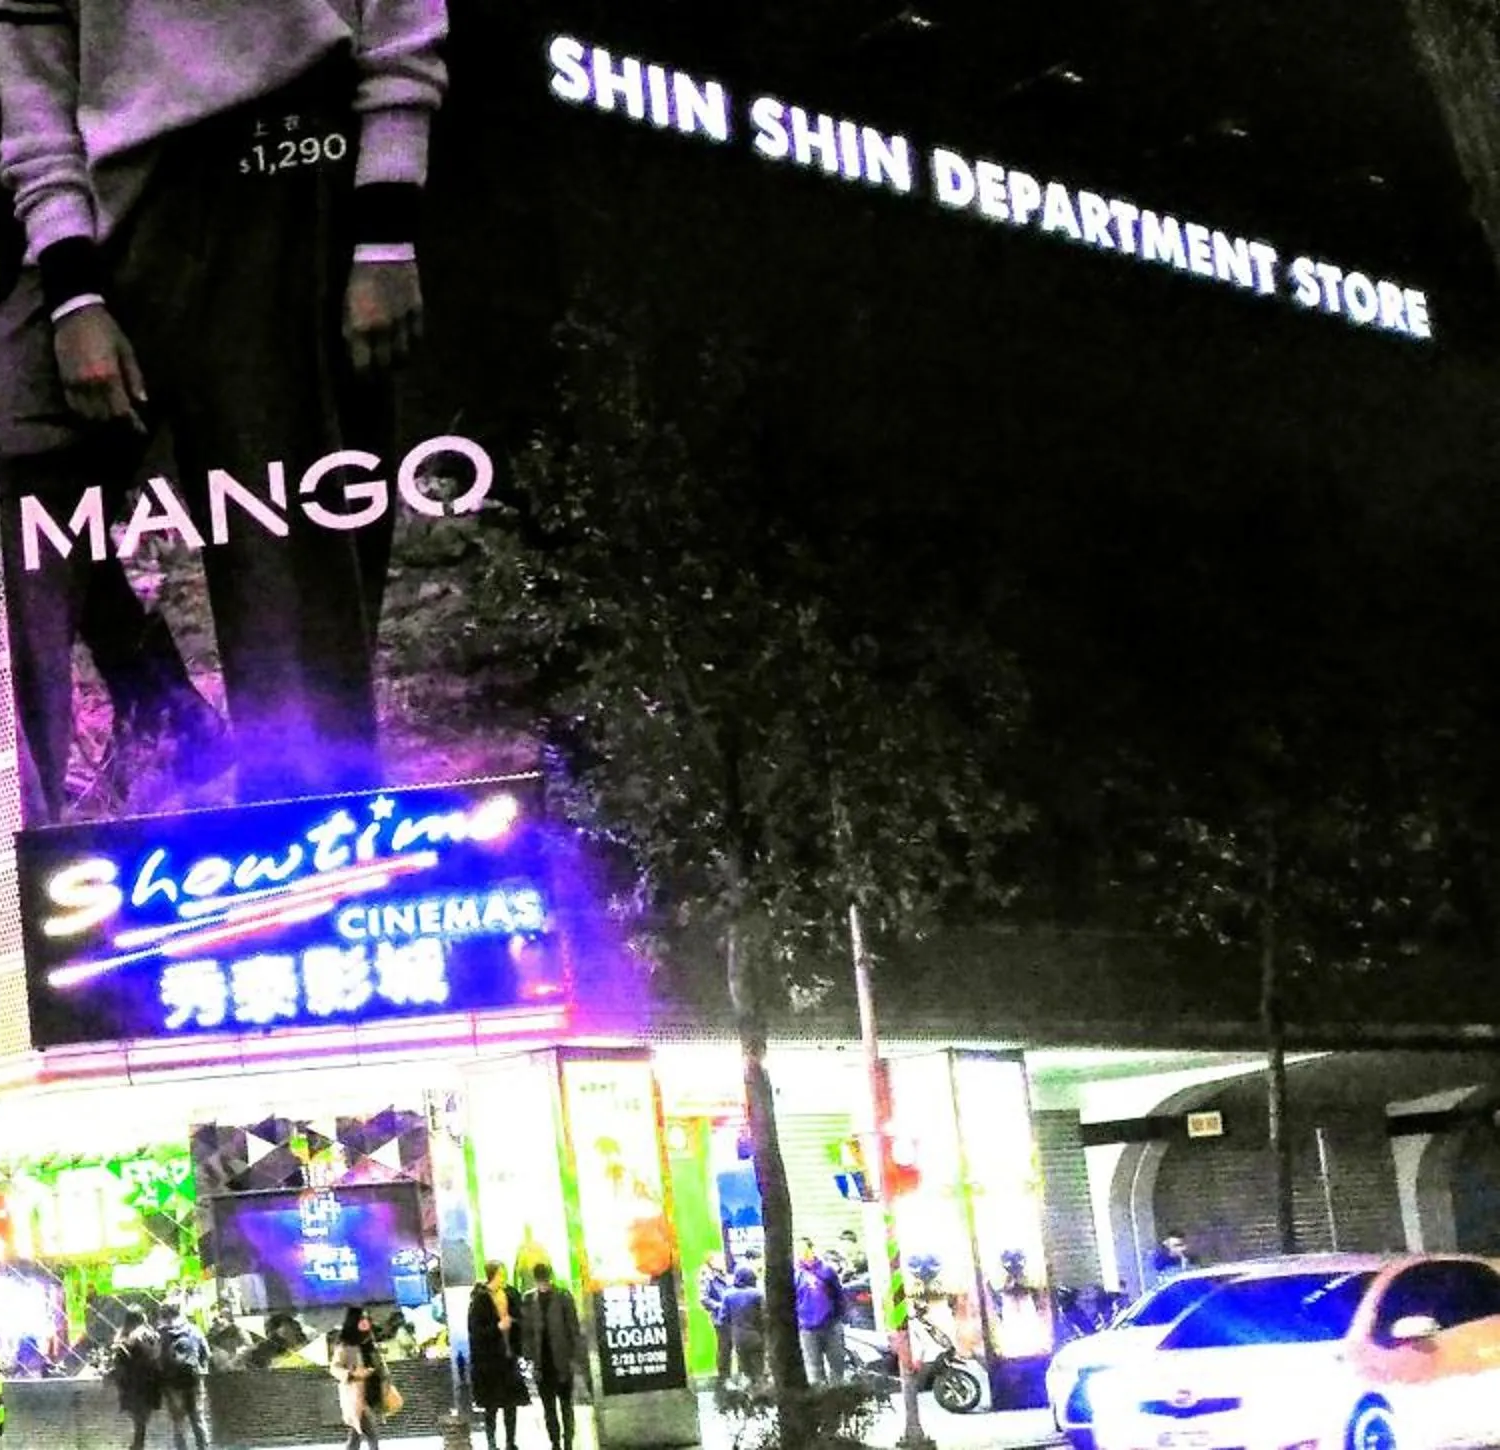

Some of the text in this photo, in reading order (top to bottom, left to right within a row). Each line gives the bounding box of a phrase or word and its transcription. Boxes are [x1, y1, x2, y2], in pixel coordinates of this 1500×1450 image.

[548, 34, 1432, 339] SHIN SHIN DEPARTMENT STORE
[19, 434, 494, 572] MANGO
[42, 794, 518, 937] Showtime
[337, 889, 543, 941] CINEMAS
[605, 1326, 668, 1349] LOGAN
